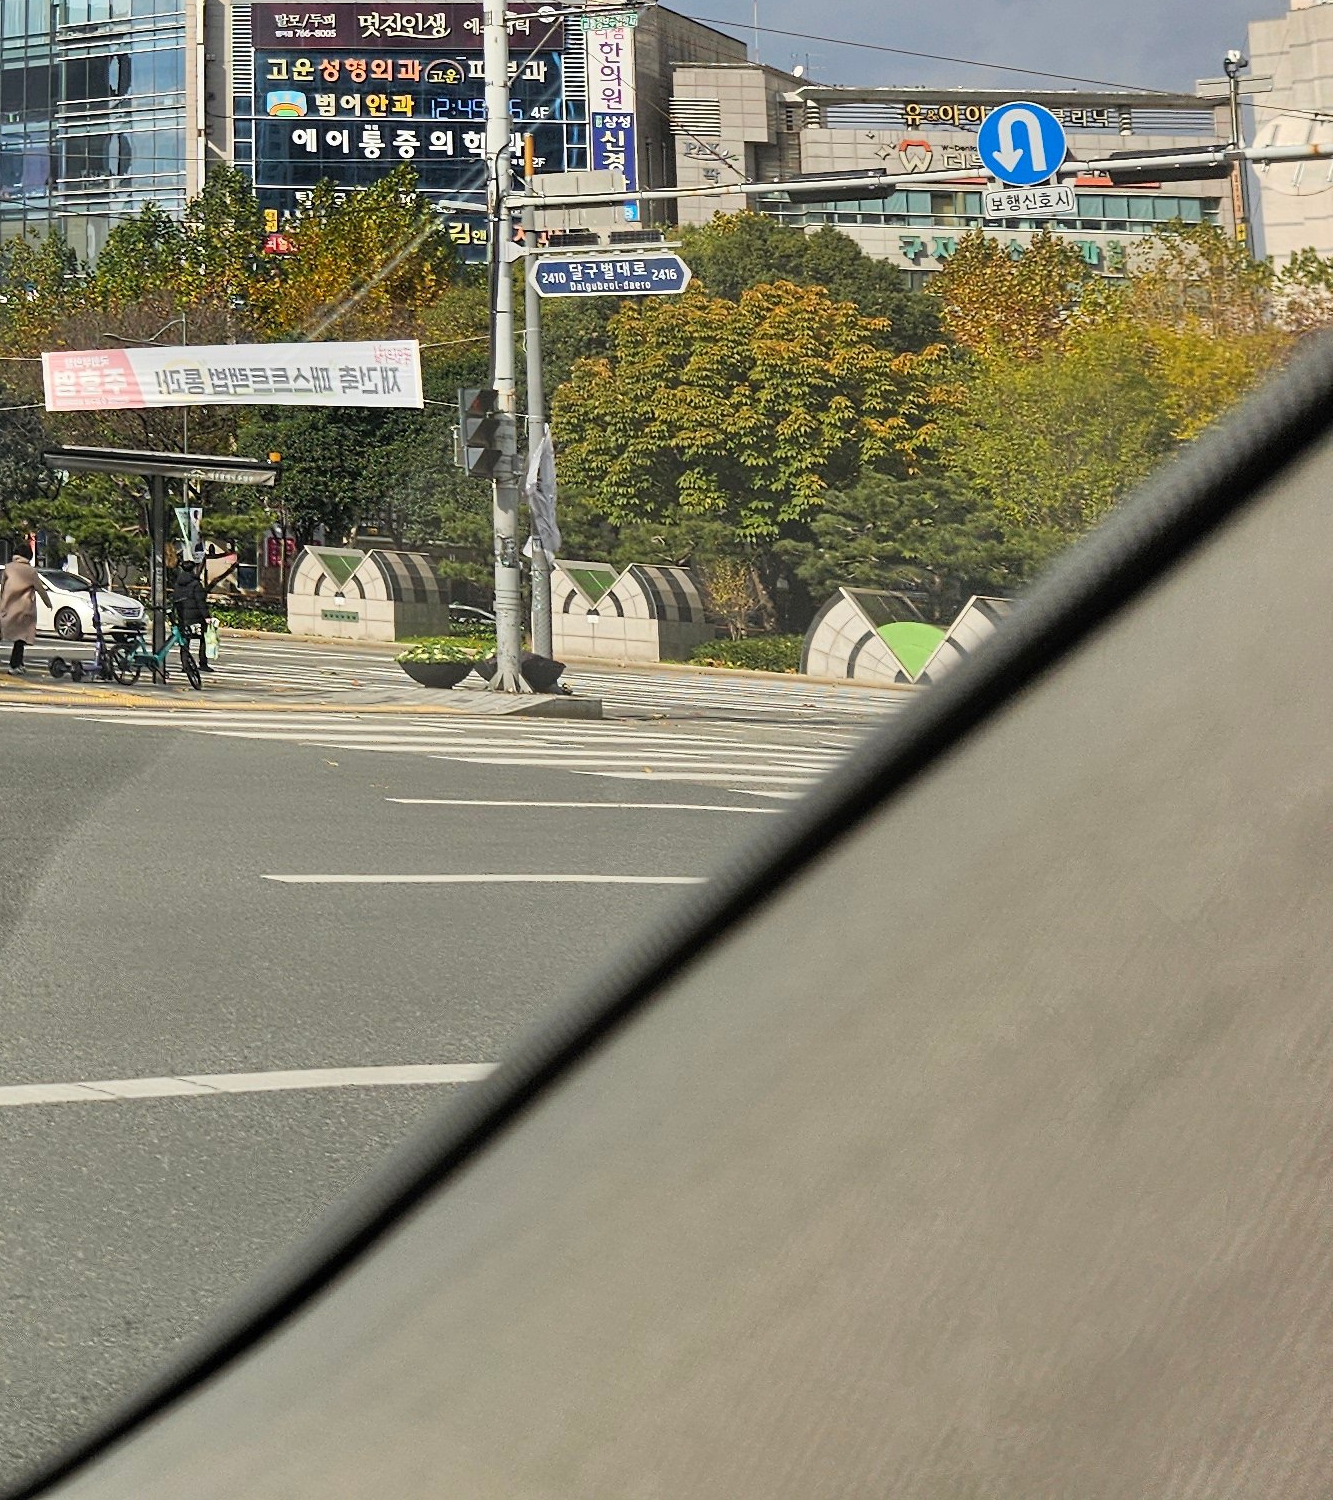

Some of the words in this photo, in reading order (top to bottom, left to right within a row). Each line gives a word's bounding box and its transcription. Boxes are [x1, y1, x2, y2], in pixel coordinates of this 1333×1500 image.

[358, 11, 452, 40] 멋진인생
[428, 70, 462, 85] 고운
[599, 41, 624, 111] 한의원
[991, 192, 1071, 213] 보행신호시
[541, 272, 567, 285] 2410
[568, 260, 648, 282] 달구벌대로
[651, 268, 678, 281] 2416
[570, 280, 651, 293] Dalgubeol-daero
